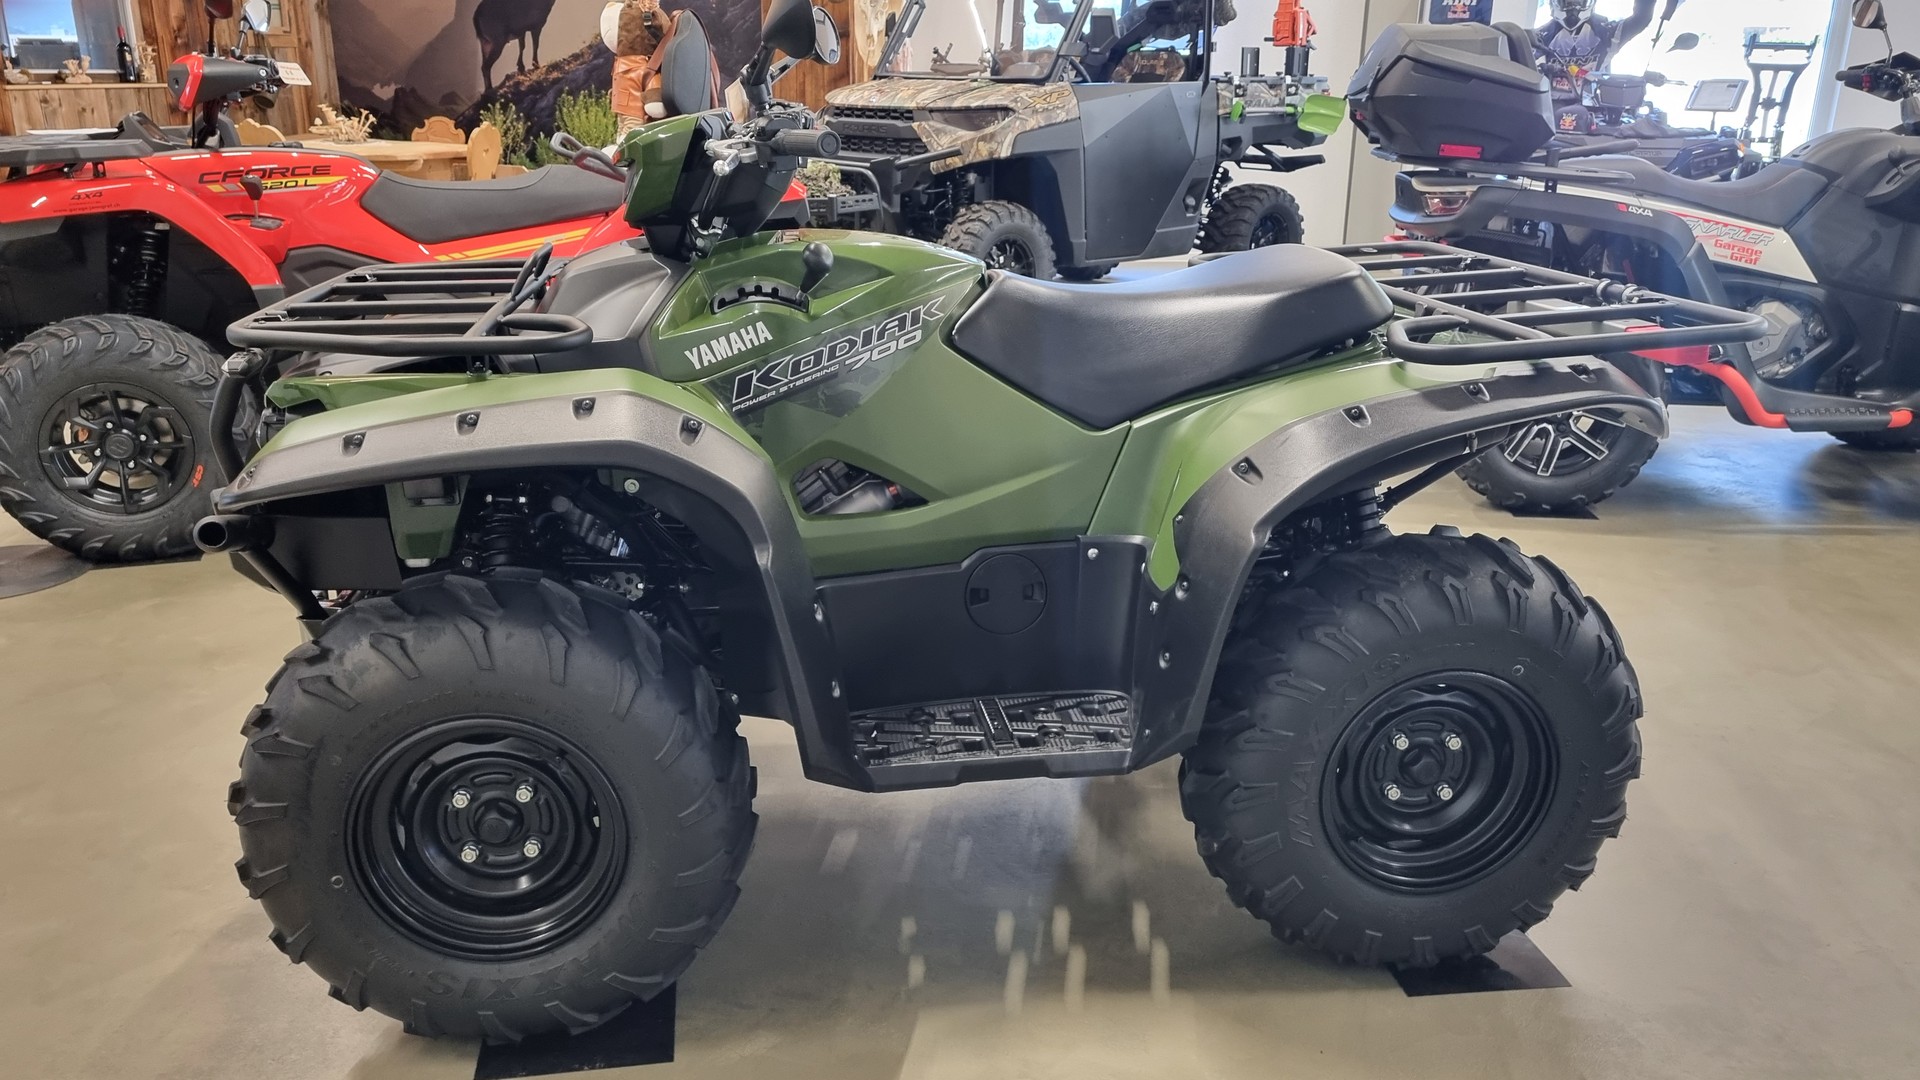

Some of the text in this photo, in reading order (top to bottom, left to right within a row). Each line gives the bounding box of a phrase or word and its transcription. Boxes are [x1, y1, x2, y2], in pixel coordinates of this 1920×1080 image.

[1024, 89, 1072, 109] XP
[198, 165, 331, 184] CFORCE
[304, 179, 317, 187] L
[1714, 239, 1762, 256] Garage
[1729, 251, 1760, 266] Graf
[684, 320, 773, 371] YAMAHA
[732, 295, 947, 404] KODIAK
[845, 329, 922, 372] 700
[732, 363, 840, 412] POWER STEERING
